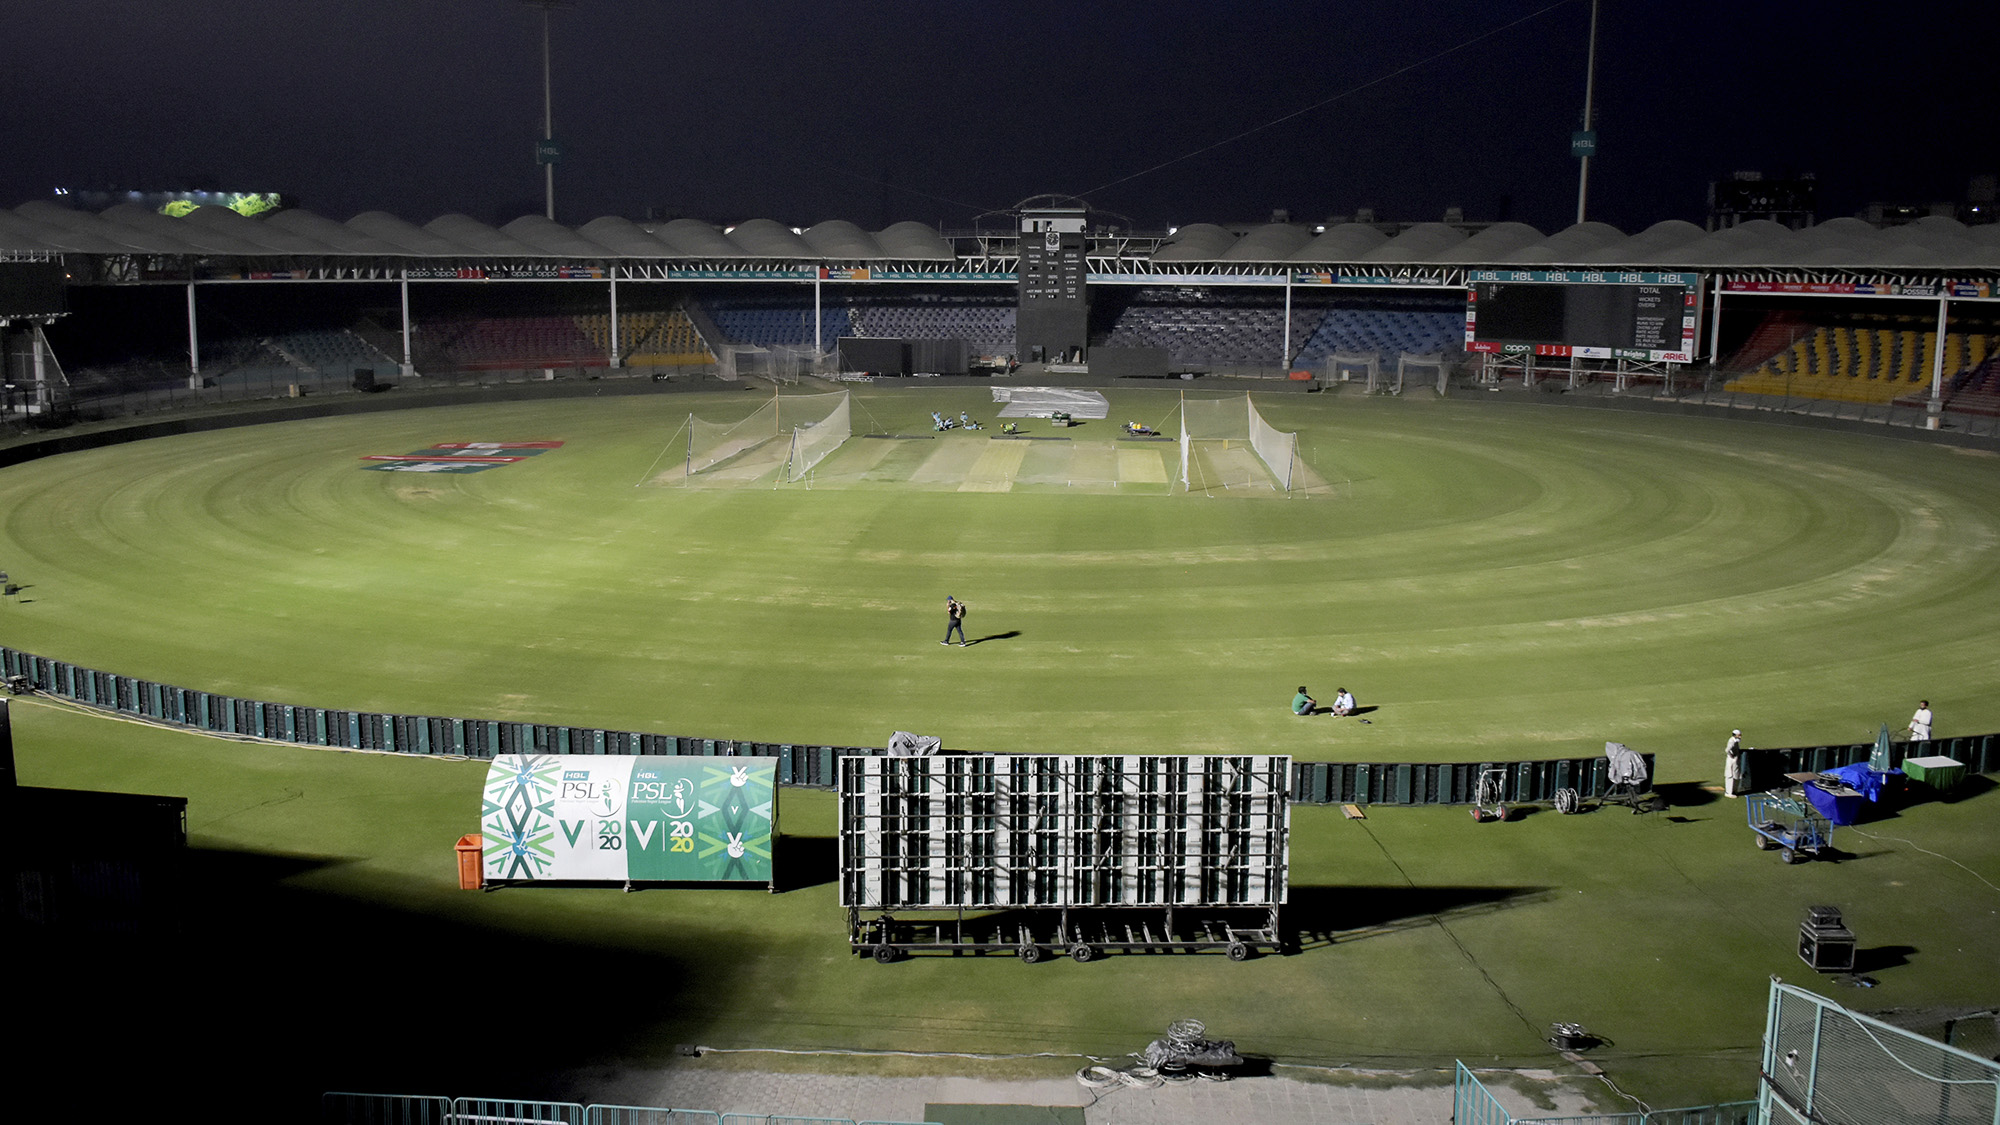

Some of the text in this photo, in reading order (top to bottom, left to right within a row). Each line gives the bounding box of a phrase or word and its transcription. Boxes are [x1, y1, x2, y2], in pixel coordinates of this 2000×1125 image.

[1478, 272, 1500, 280] HBL
[1511, 272, 1534, 281] HBL
[1546, 273, 1570, 282] HBL
[1582, 273, 1607, 282] HBL
[1619, 274, 1645, 283] HBL
[1658, 274, 1685, 283] HBL
[1663, 353, 1688, 361] ARIEL
[560, 782, 600, 799] PSL
[632, 782, 672, 799] PSL
[599, 820, 621, 835] 20
[670, 821, 693, 837] 20
[599, 836, 622, 850] 20
[670, 837, 694, 853] 20
